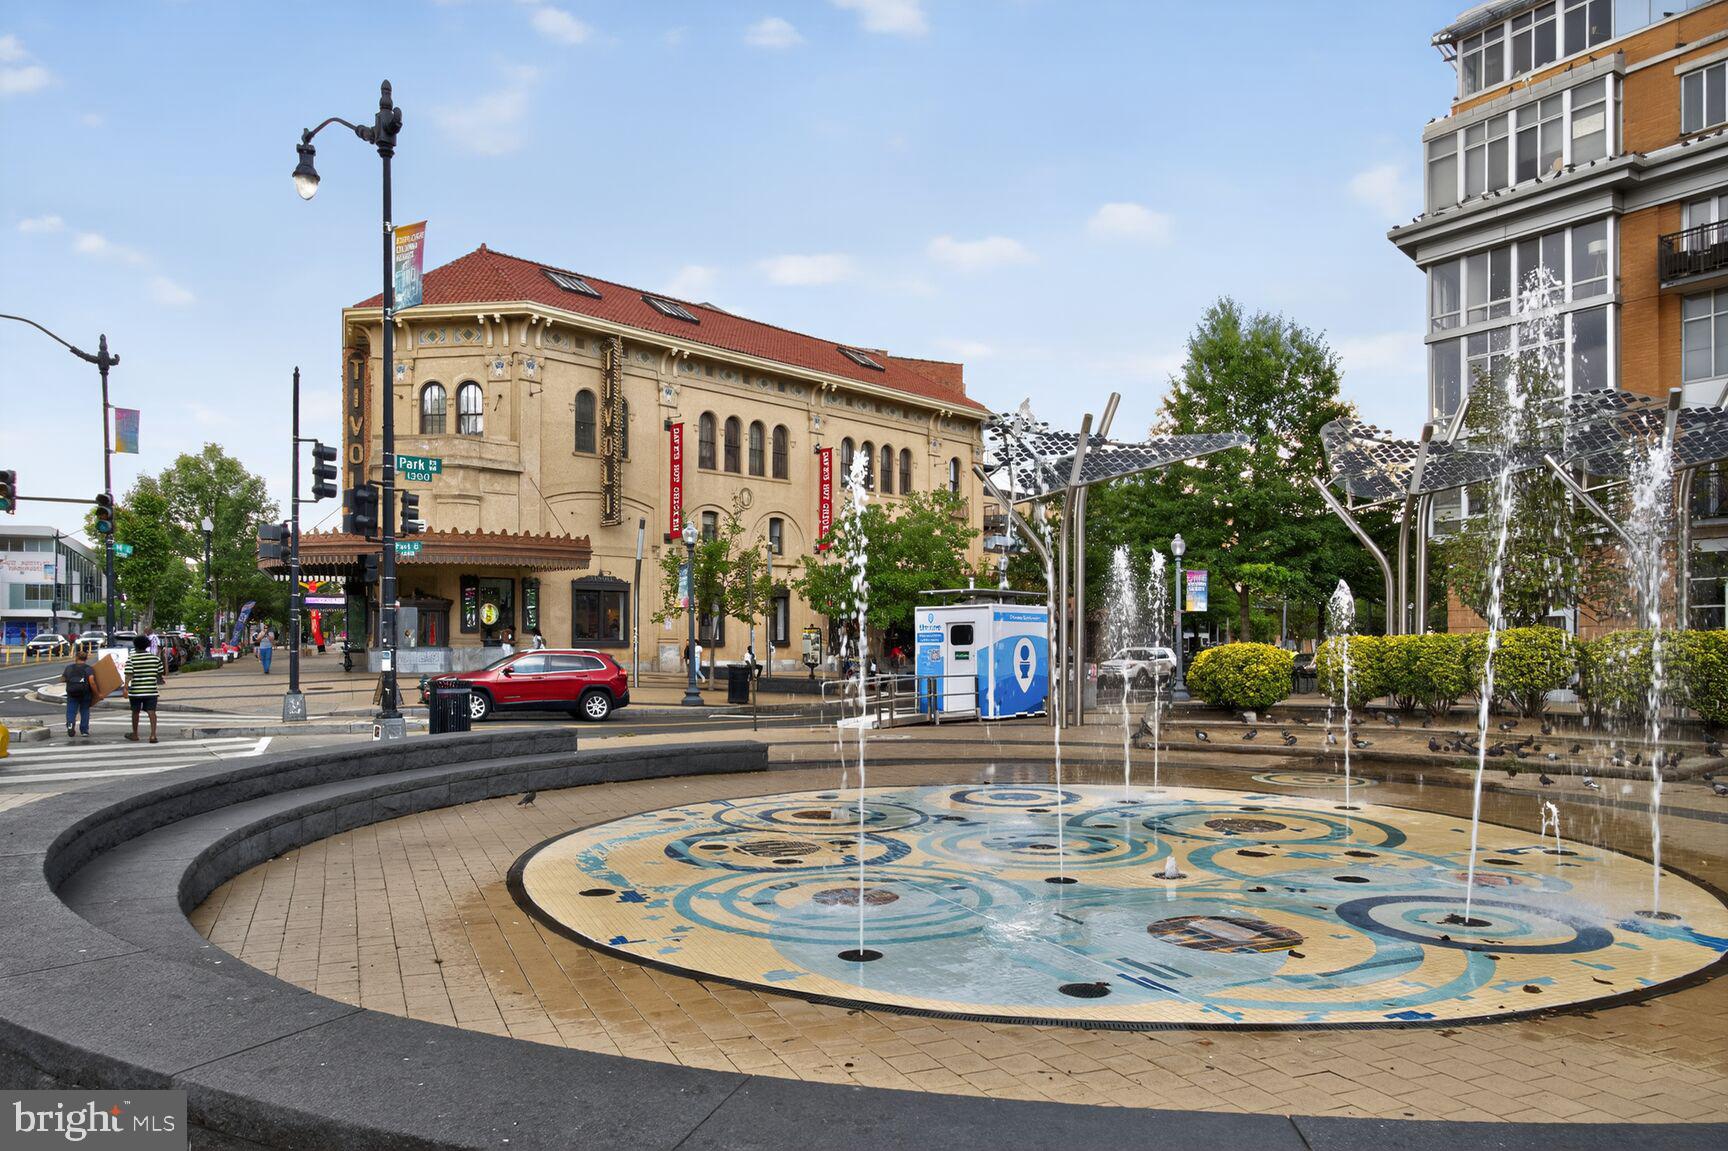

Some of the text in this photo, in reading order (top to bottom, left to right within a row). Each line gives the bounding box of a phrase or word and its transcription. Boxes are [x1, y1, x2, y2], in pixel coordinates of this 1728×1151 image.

[349, 360, 364, 489] TIVOL
[399, 457, 425, 471] Park
[407, 472, 430, 481] 1300
